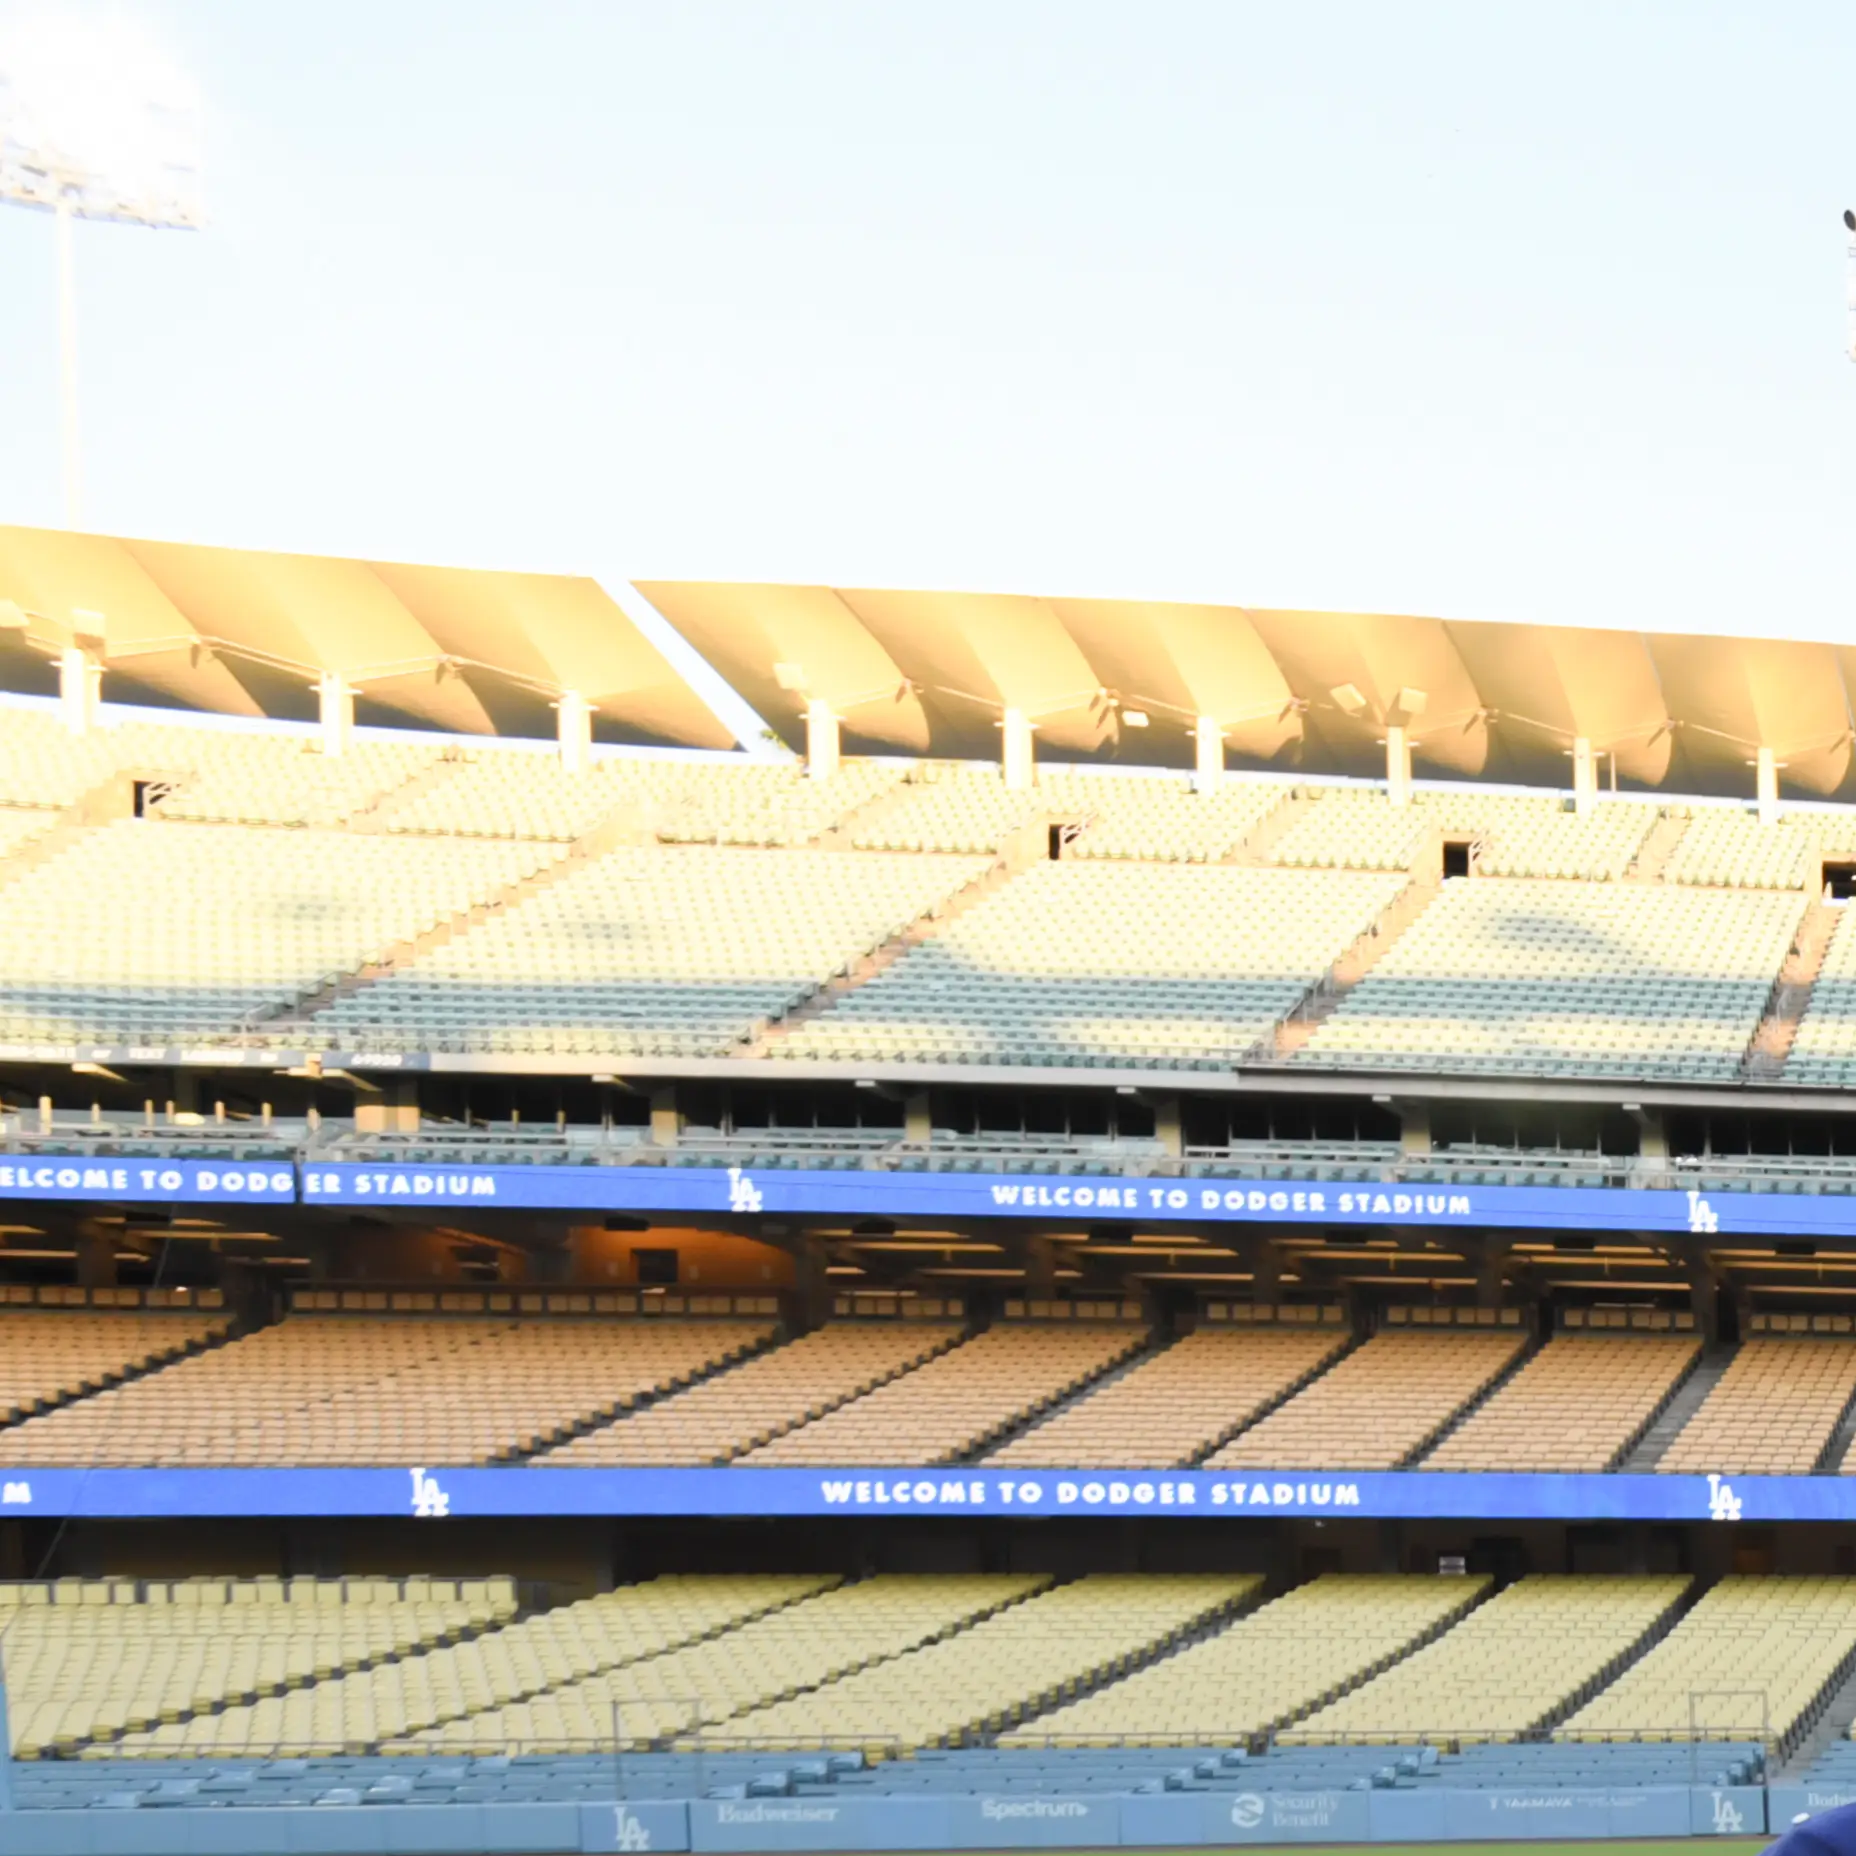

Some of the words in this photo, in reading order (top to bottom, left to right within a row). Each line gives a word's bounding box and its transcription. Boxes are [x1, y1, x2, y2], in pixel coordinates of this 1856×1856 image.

[0, 1166, 128, 1189] ELCOME
[140, 1169, 182, 1190] TO
[355, 1174, 496, 1196] STADIUM
[727, 1168, 762, 1212] LA
[991, 1186, 1137, 1209] WELCOME
[1149, 1188, 1188, 1209] TO
[1201, 1190, 1326, 1212] DODGER
[1338, 1192, 1470, 1215] STADIUM
[410, 1468, 449, 1517] LA
[821, 1481, 985, 1504] WELCOME
[999, 1482, 1043, 1504] TO
[1057, 1483, 1196, 1505] DODGER
[1211, 1484, 1360, 1506] STADIUM
[1707, 1474, 1743, 1521] LA
[717, 1801, 840, 1823] Budweiser
[981, 1798, 1083, 1821] Spectrum
[1711, 1791, 1743, 1833] LA
[614, 1806, 649, 1851] LA
